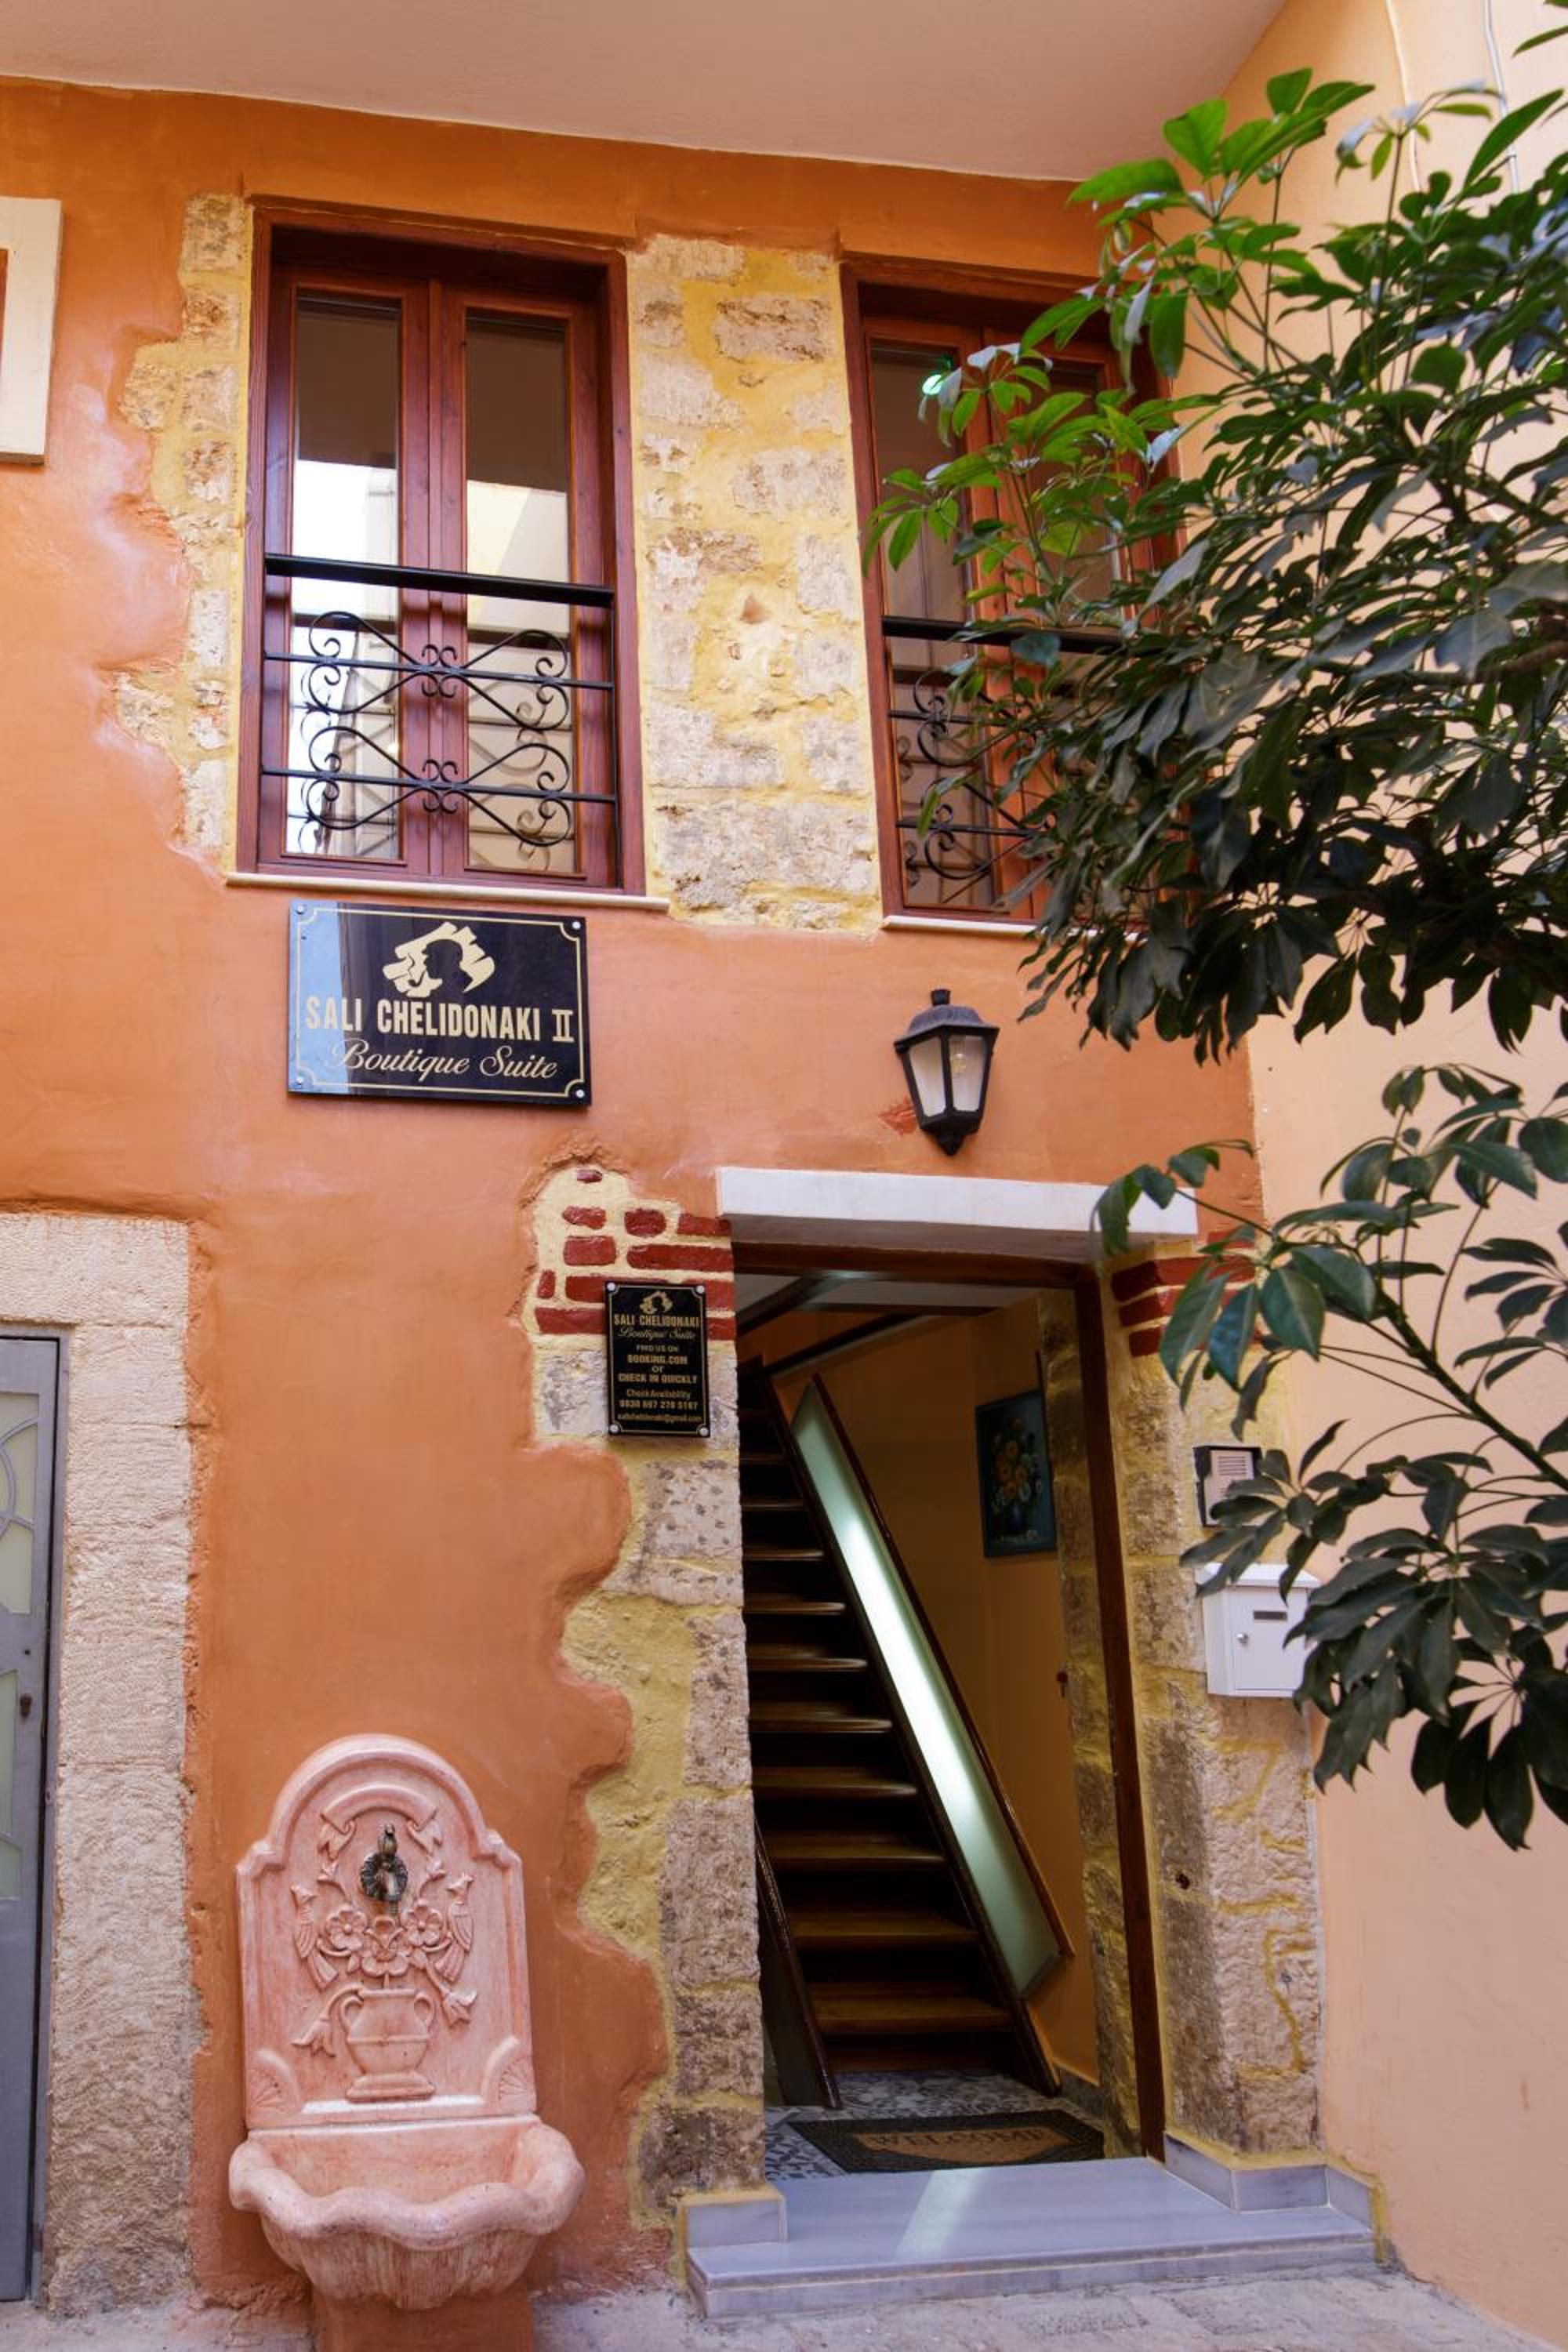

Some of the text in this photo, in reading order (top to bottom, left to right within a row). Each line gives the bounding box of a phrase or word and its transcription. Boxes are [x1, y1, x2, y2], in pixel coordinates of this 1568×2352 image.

[306, 996, 575, 1043] SALI CHELIDONAKI II
[332, 1037, 558, 1082] Boutique Suite
[614, 1314, 699, 1327] SALI CHELIDONAKI
[618, 1327, 695, 1341] Boutique Suite
[636, 1344, 654, 1352] FIND
[627, 1354, 688, 1365] BOOKING.COM
[619, 1374, 697, 1384] CHECK IN QUICKLY
[651, 1389, 691, 1400] Availability
[868, 2128, 1045, 2146] WELCOME
